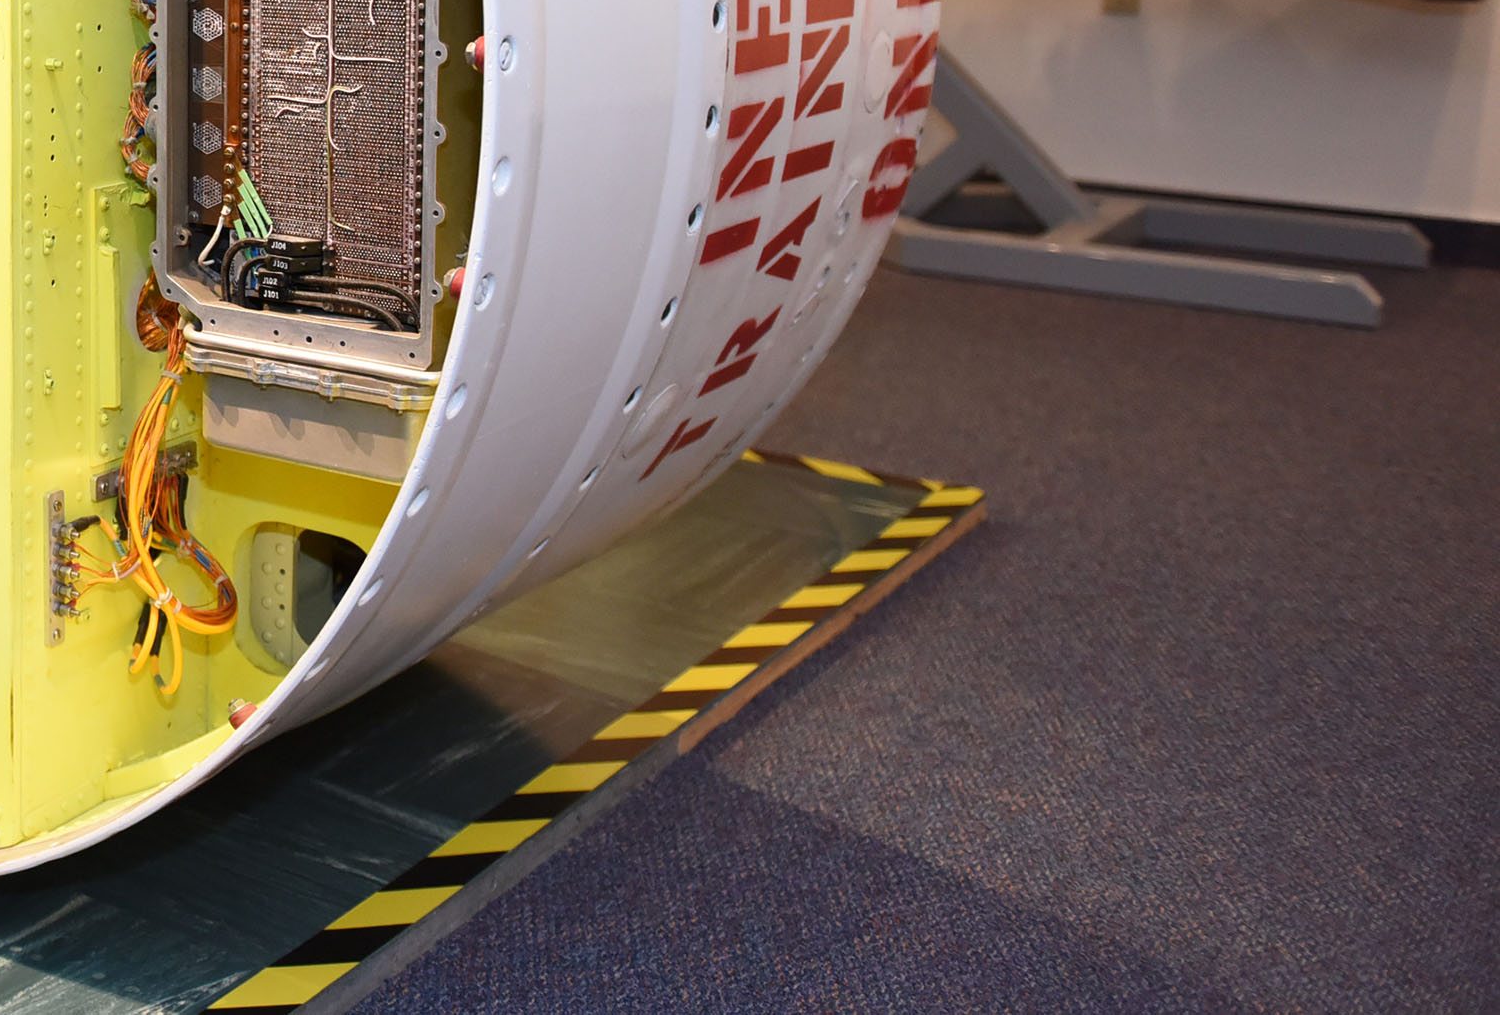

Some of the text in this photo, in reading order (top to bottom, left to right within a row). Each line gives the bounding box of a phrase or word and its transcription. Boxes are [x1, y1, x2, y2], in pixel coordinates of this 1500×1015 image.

[271, 241, 287, 251] J104
[272, 260, 288, 269] J103
[262, 276, 278, 285] J102
[263, 289, 279, 299] J101
